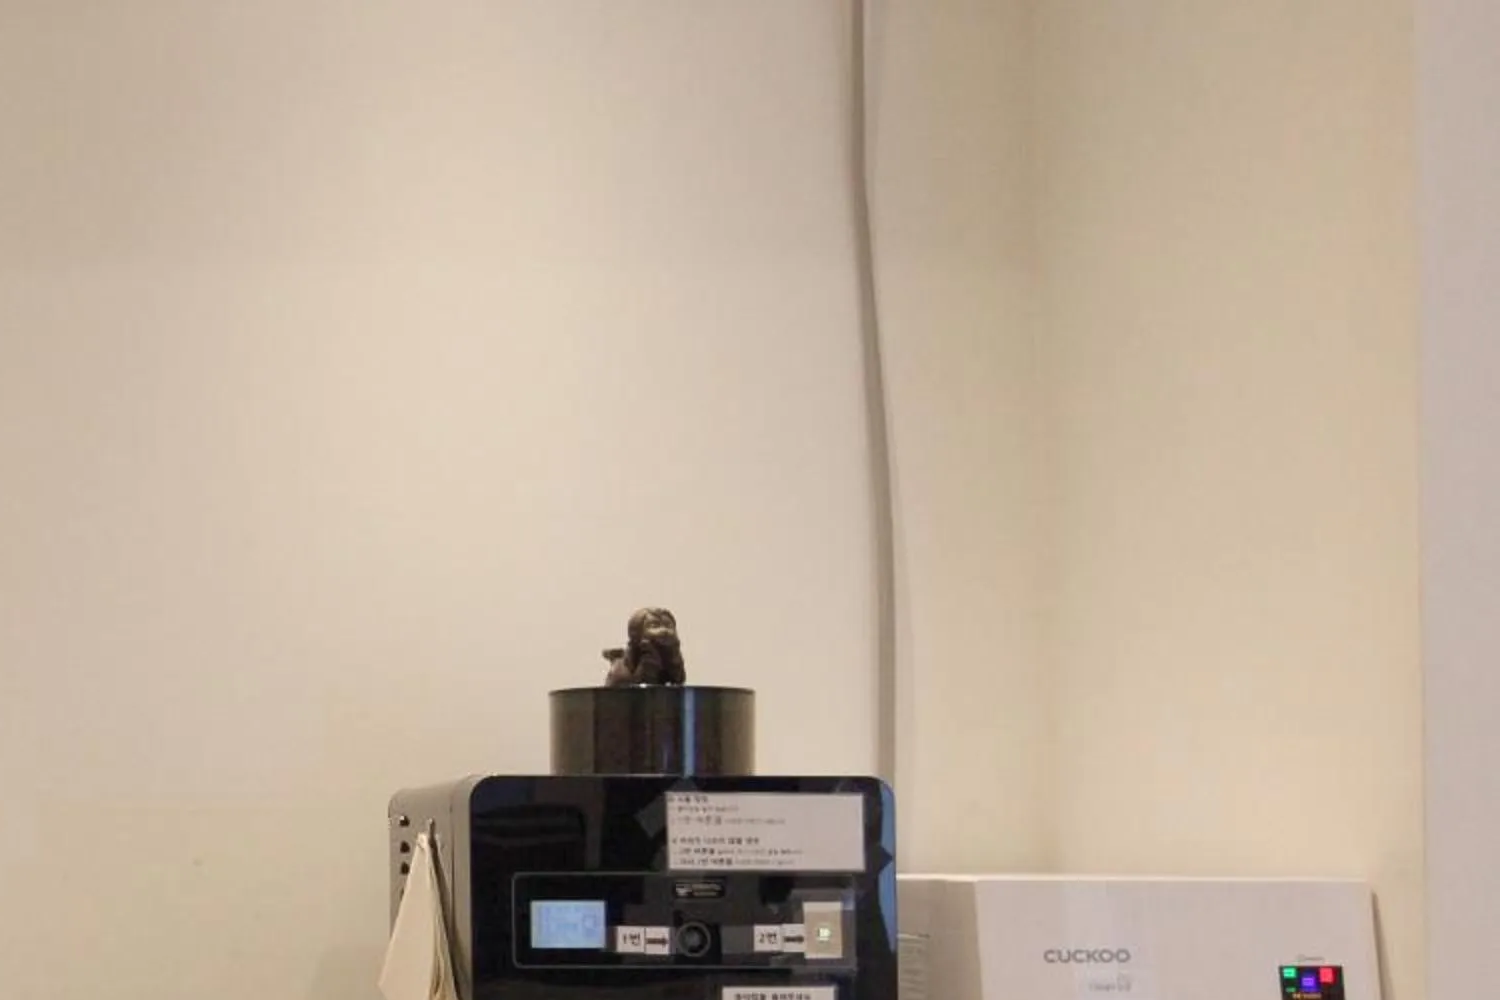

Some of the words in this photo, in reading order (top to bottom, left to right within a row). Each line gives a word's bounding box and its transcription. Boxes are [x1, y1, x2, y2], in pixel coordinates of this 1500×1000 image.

[621, 932, 642, 948] 1번
[758, 931, 779, 946] 2번
[1041, 947, 1133, 965] CUCKOO
